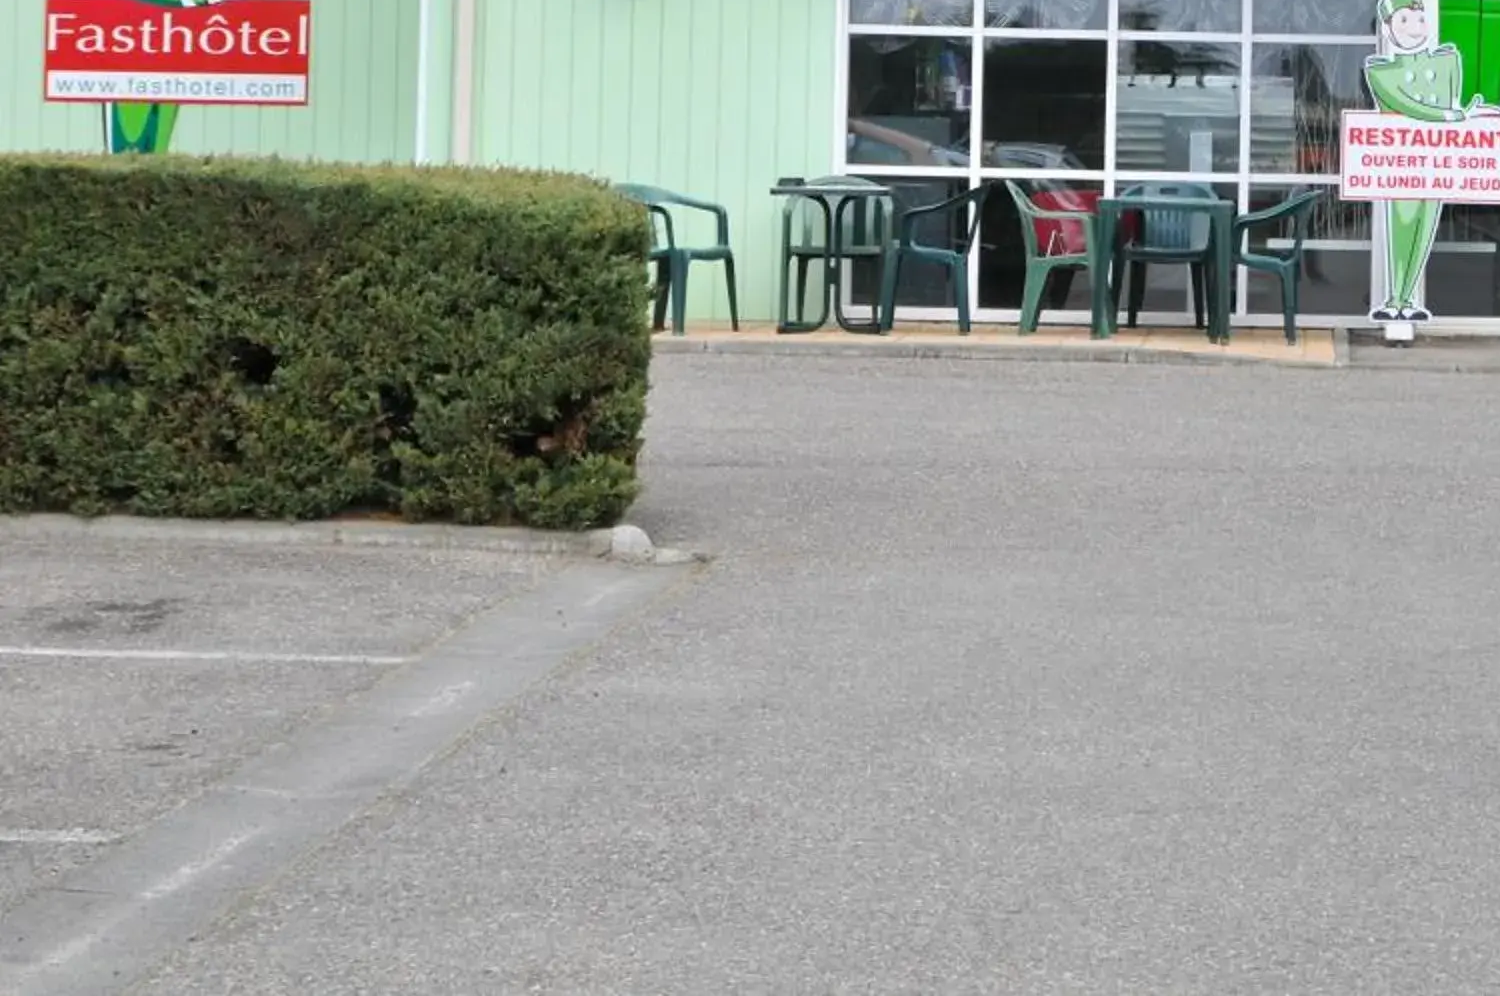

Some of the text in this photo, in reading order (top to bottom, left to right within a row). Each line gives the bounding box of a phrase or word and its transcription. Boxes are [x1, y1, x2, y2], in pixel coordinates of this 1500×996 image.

[46, 11, 309, 56] Fasthôtel
[54, 76, 297, 98] www.fasthotel.com
[1361, 154, 1497, 170] OUVERT LE SOIR
[1349, 175, 1372, 187] DU
[1377, 175, 1426, 189] LUNDI
[1431, 177, 1453, 190] AU
